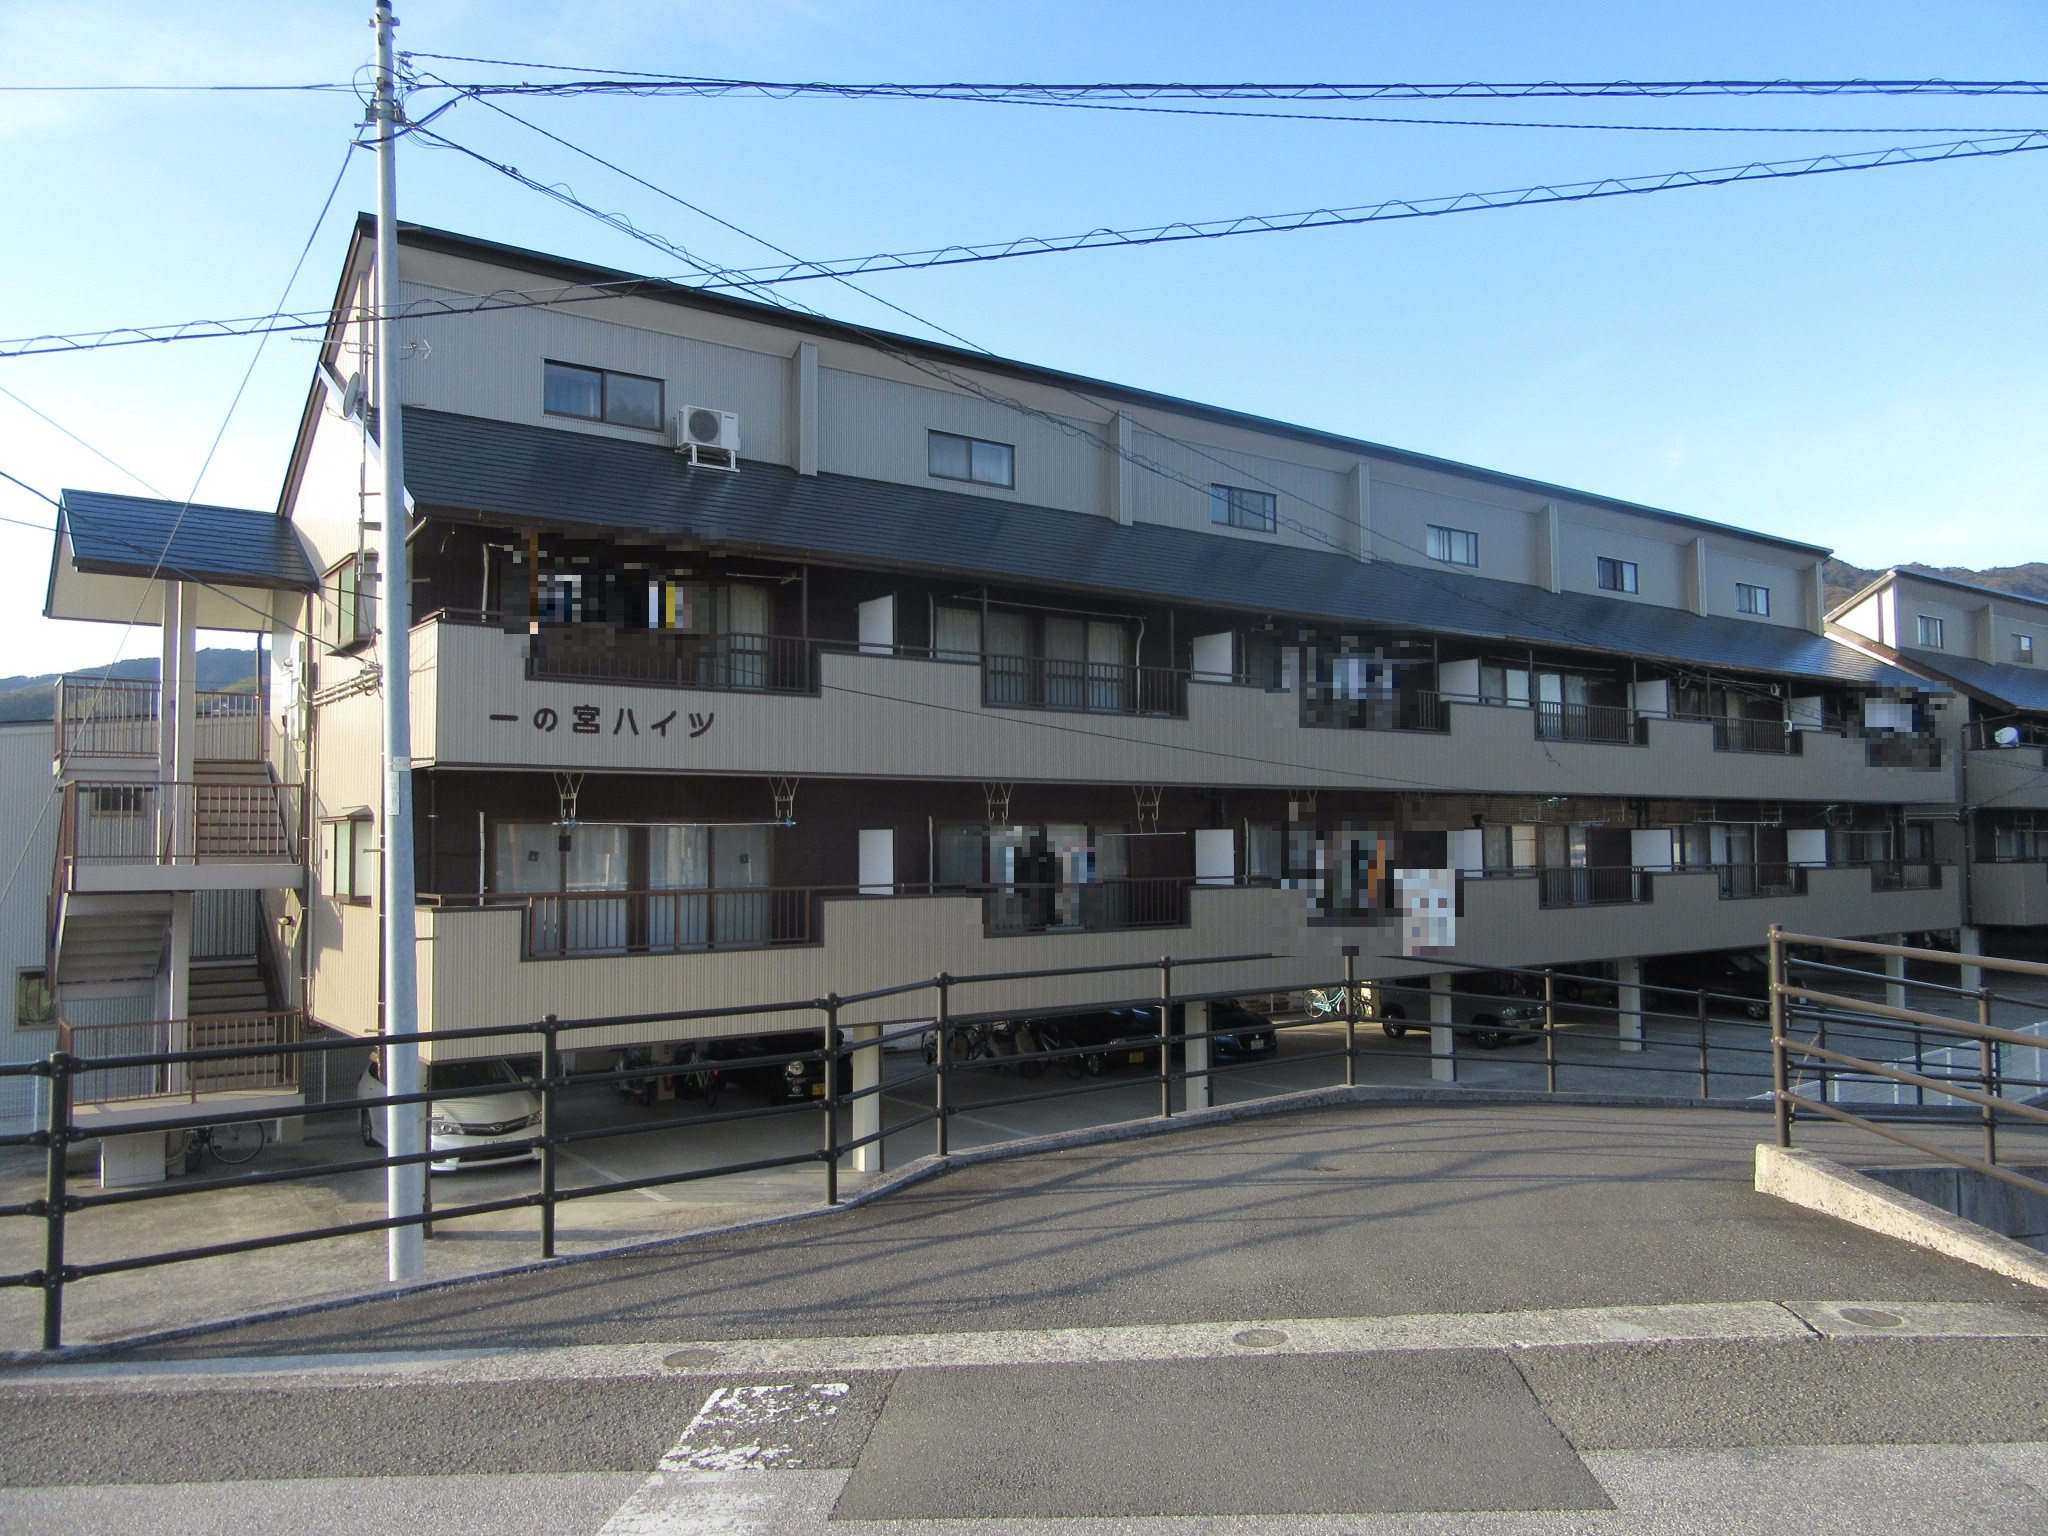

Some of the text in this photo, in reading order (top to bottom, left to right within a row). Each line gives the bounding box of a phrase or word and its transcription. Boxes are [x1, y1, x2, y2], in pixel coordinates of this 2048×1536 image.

[489, 704, 715, 738] 一の宮ハイツ
